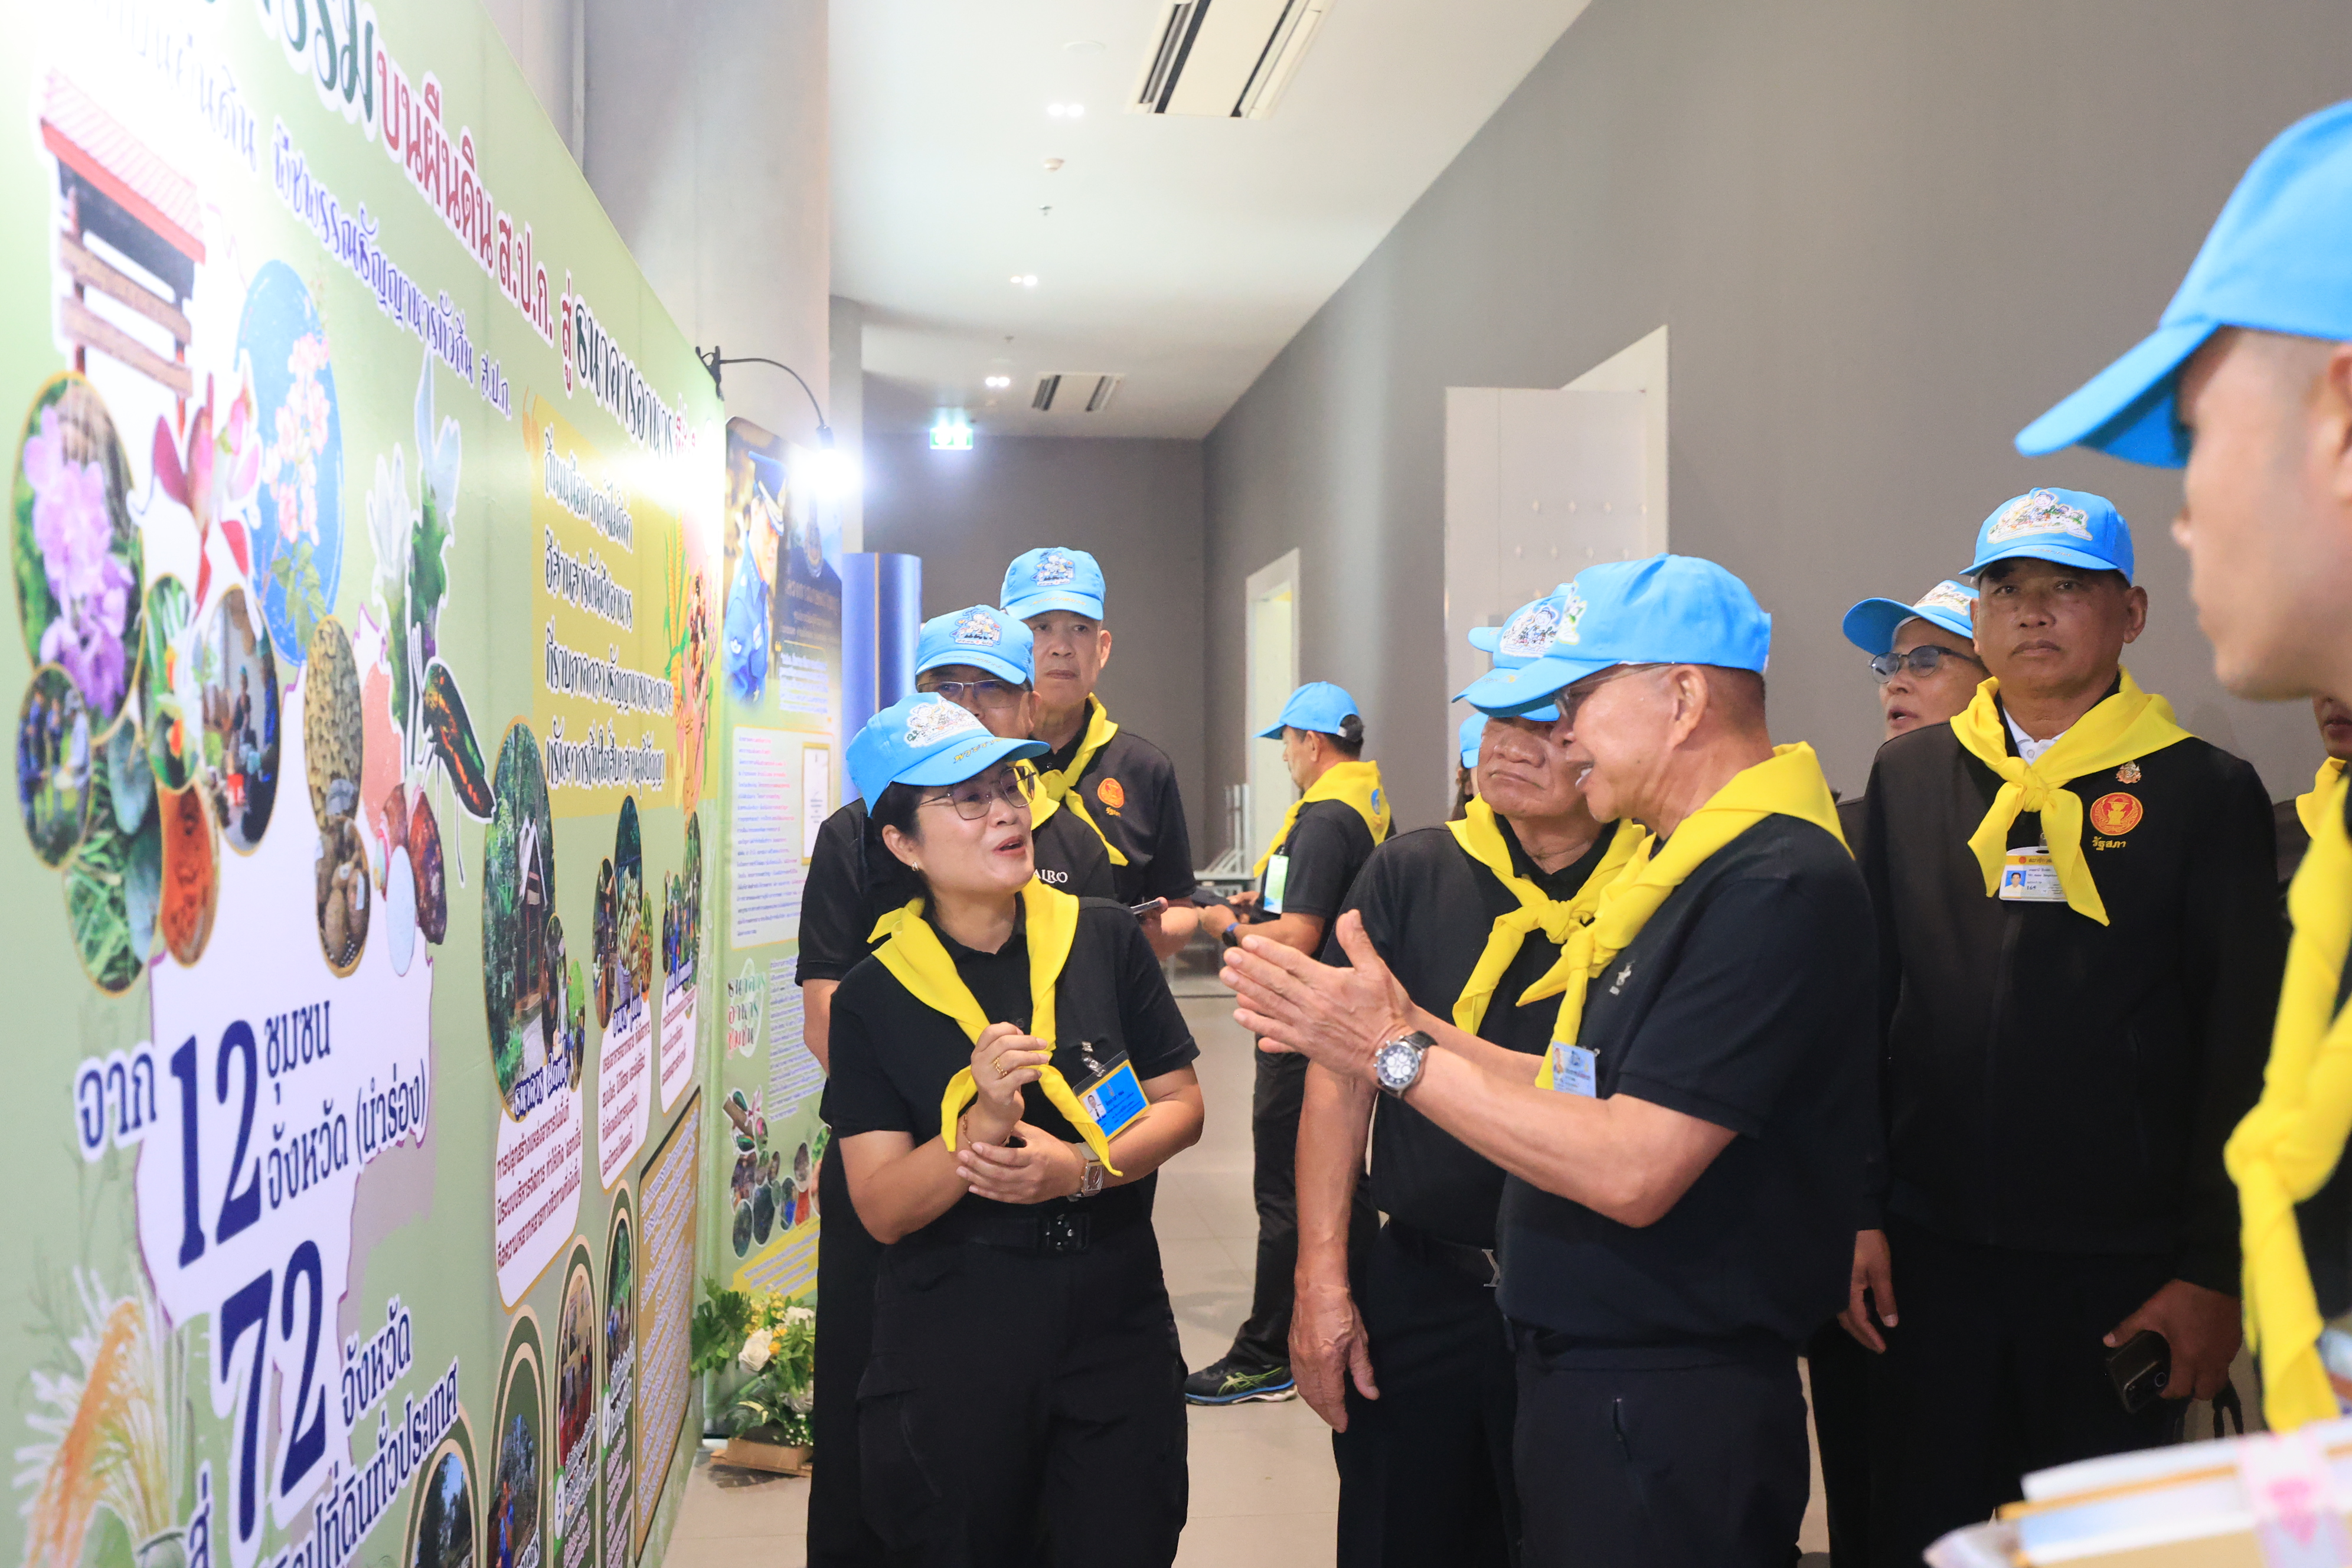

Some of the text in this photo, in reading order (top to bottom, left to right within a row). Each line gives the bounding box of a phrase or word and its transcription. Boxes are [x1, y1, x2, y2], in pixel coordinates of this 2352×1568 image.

[499, 218, 553, 341] ส.ป.ก.
[482, 355, 512, 415] ส.ป.ก.
[1034, 870, 1068, 883] ALRO
[2092, 837, 2126, 851] รัฐสภา
[264, 999, 331, 1105] ชุมชน
[515, 1069, 543, 1117] ธนาคาร
[547, 1039, 567, 1092] Bank
[79, 1020, 261, 1269] จาก 12
[268, 1061, 426, 1211] จังหวัด (นำร่อง)
[220, 1240, 326, 1543] 72
[342, 1302, 412, 1428] จังหวัด
